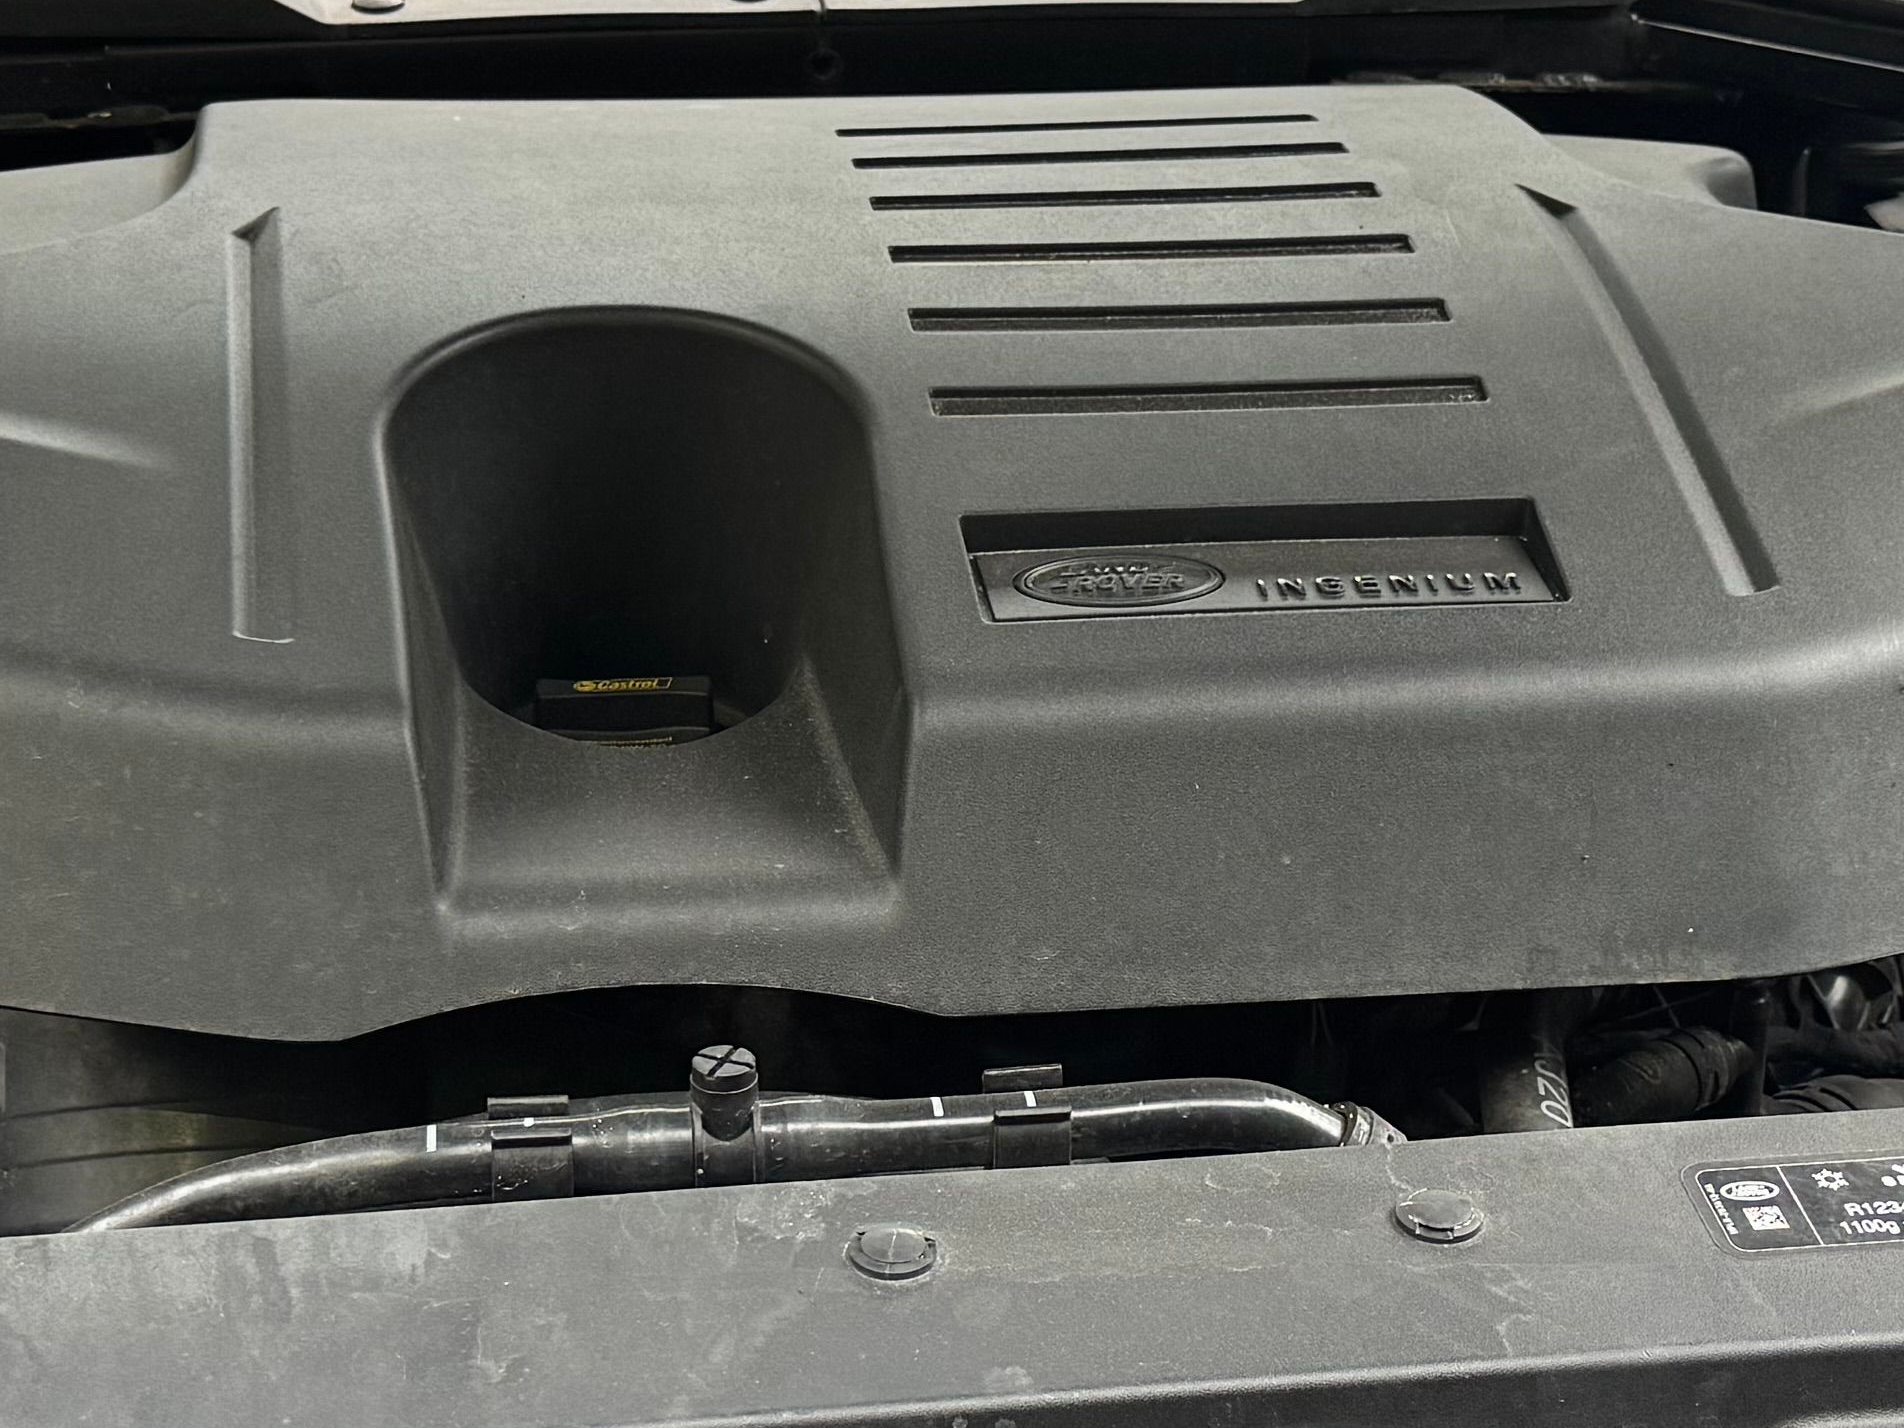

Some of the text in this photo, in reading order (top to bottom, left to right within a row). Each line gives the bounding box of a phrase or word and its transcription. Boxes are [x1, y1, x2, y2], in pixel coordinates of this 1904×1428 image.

[1075, 572, 1185, 593] ROVER
[1255, 571, 1522, 601] INGENIUM
[596, 677, 659, 691] Castrol
[1840, 1218, 1900, 1235] 1100g
